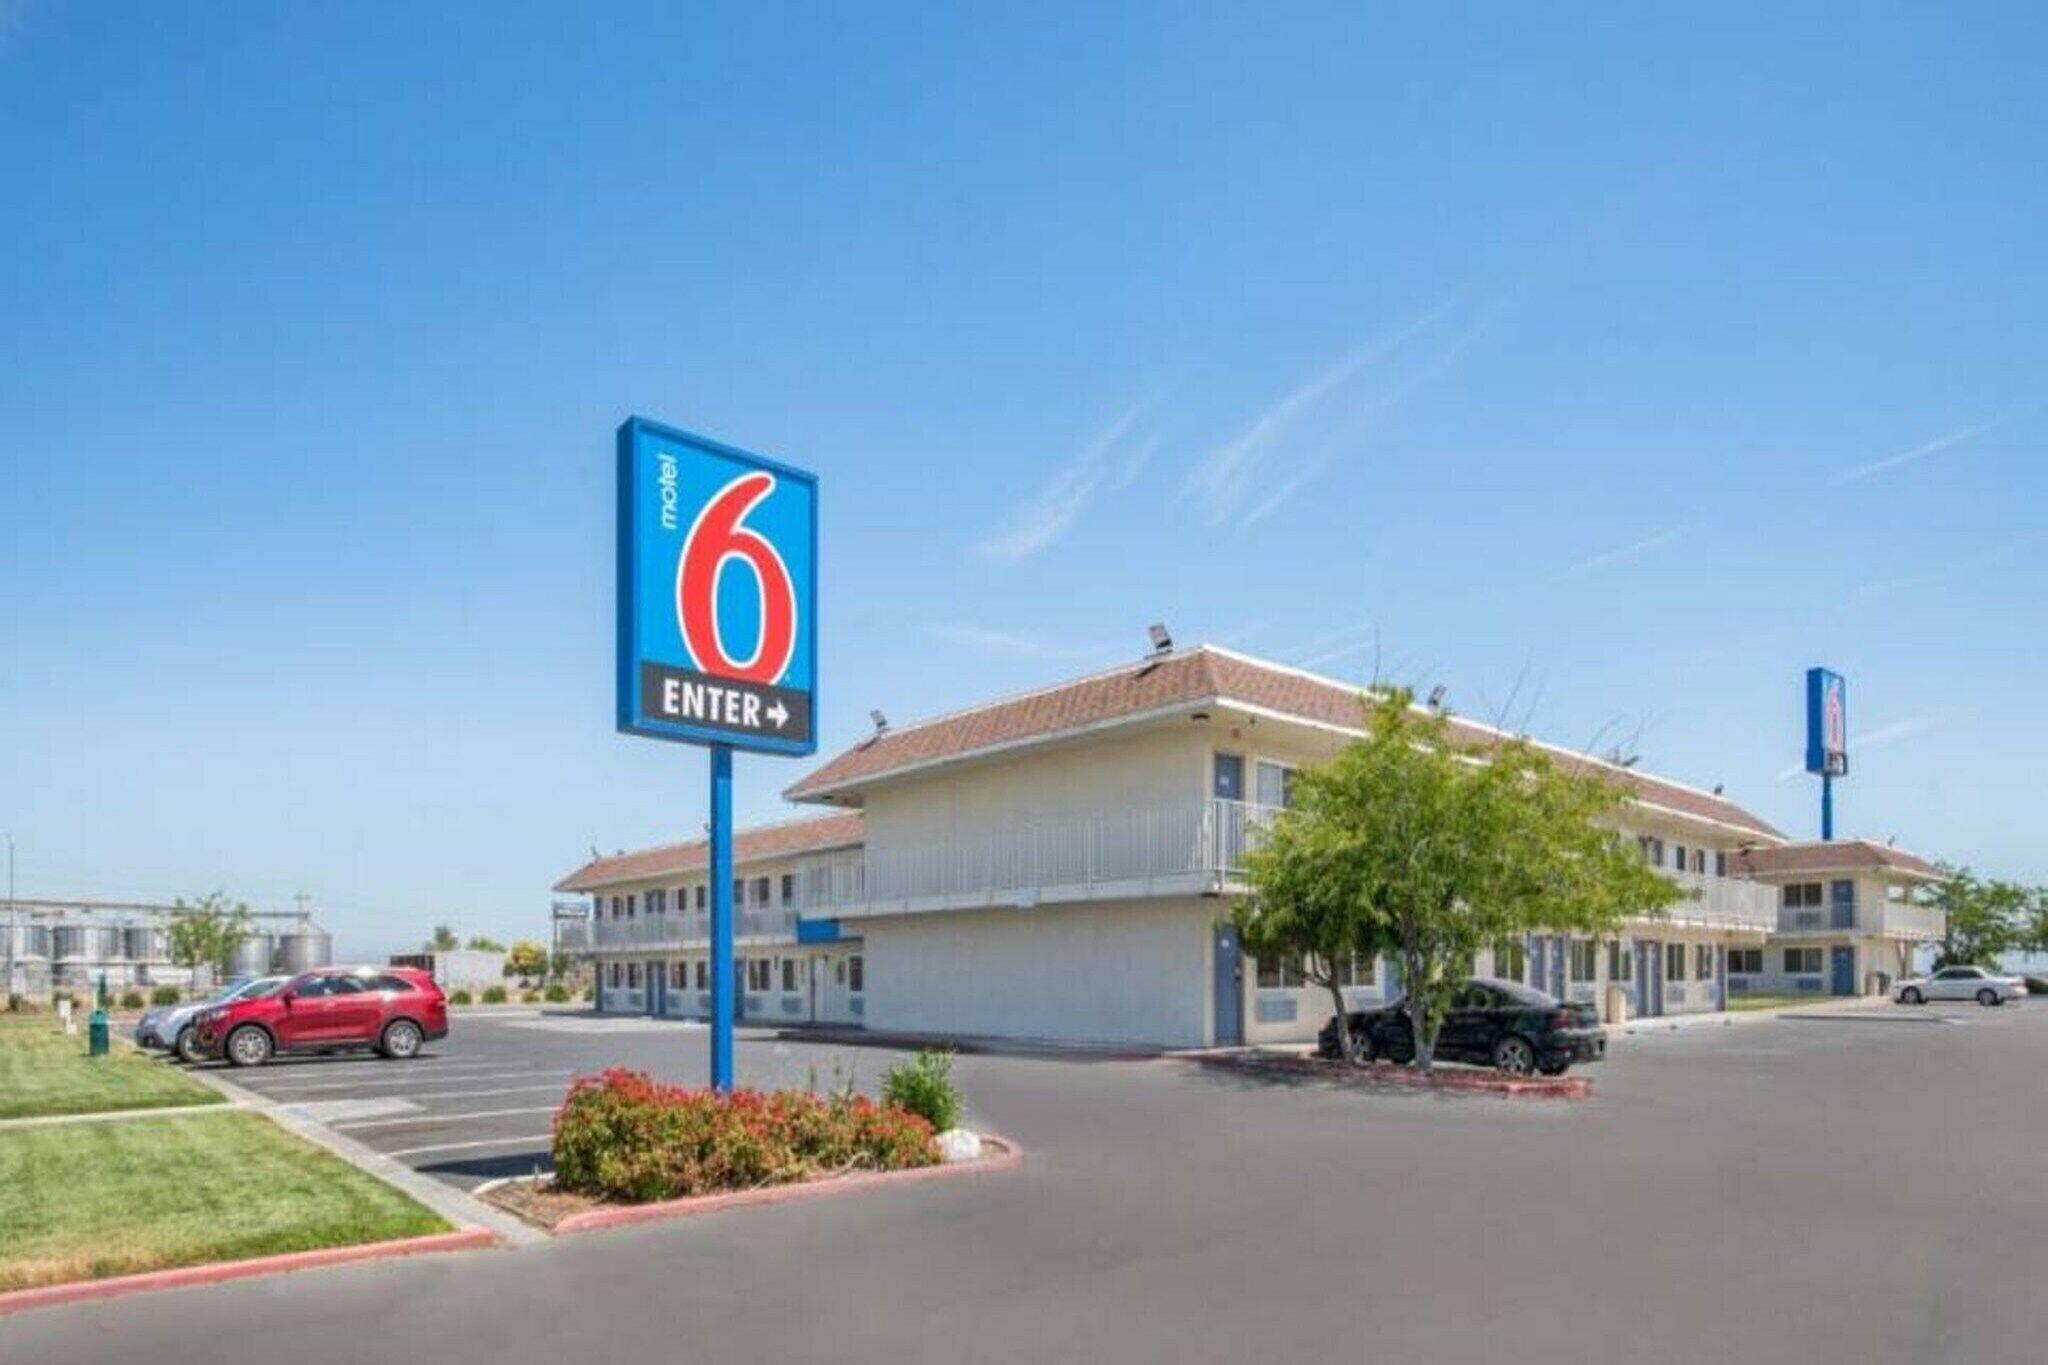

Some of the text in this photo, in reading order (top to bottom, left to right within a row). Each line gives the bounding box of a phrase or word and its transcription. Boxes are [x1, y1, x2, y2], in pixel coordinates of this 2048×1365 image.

[657, 454, 679, 530] motel
[676, 471, 797, 685] 6
[663, 678, 760, 728] ENTER
